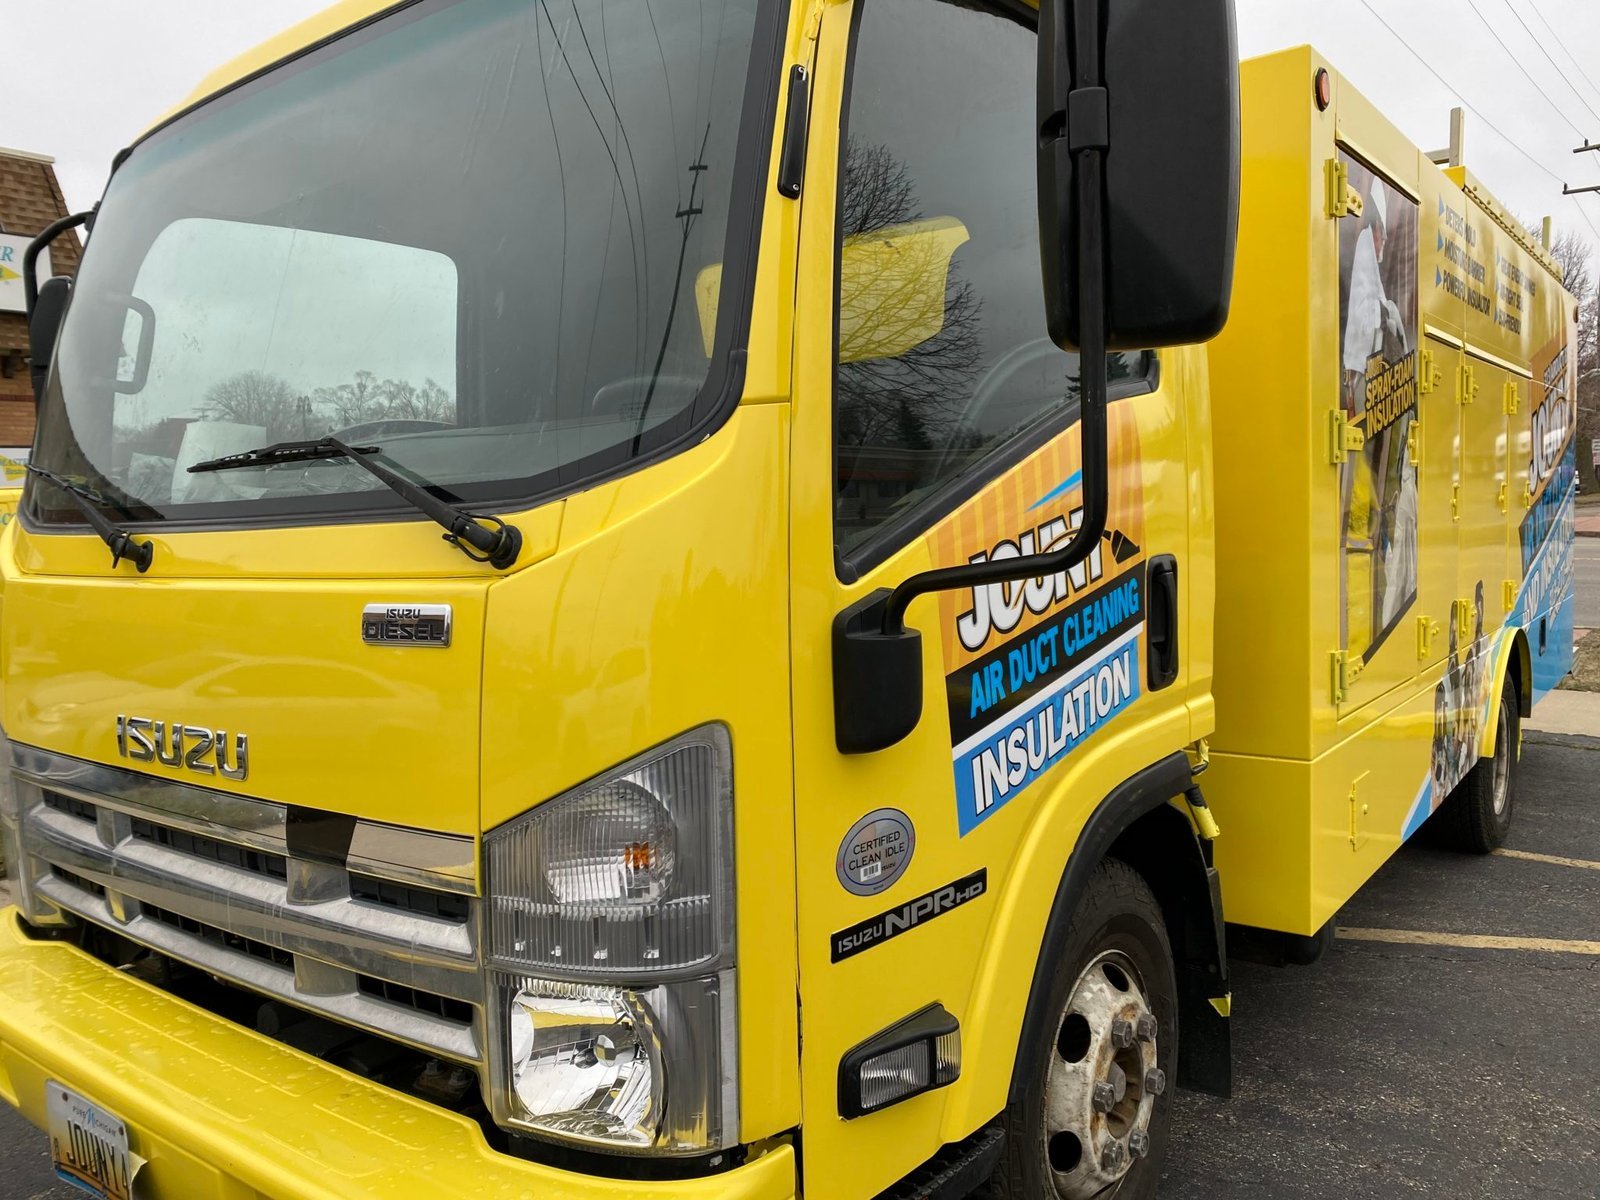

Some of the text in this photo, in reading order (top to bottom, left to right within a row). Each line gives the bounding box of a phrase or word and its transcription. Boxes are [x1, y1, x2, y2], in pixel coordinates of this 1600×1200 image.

[1365, 353, 1415, 408] SPRAY-FOAM
[1366, 381, 1415, 440] INSULATION
[365, 621, 445, 641] DIESEL
[386, 608, 421, 619] ISUZU
[970, 576, 1139, 720] AIR DUCT CLEANING
[116, 713, 248, 782] ISUZU
[971, 650, 1131, 817] INSULATION
[848, 842, 905, 871] CLEAN IDLE
[852, 830, 901, 856] CERTIFIED
[838, 923, 883, 954] ISUZU
[66, 1119, 119, 1191] JOUNY
